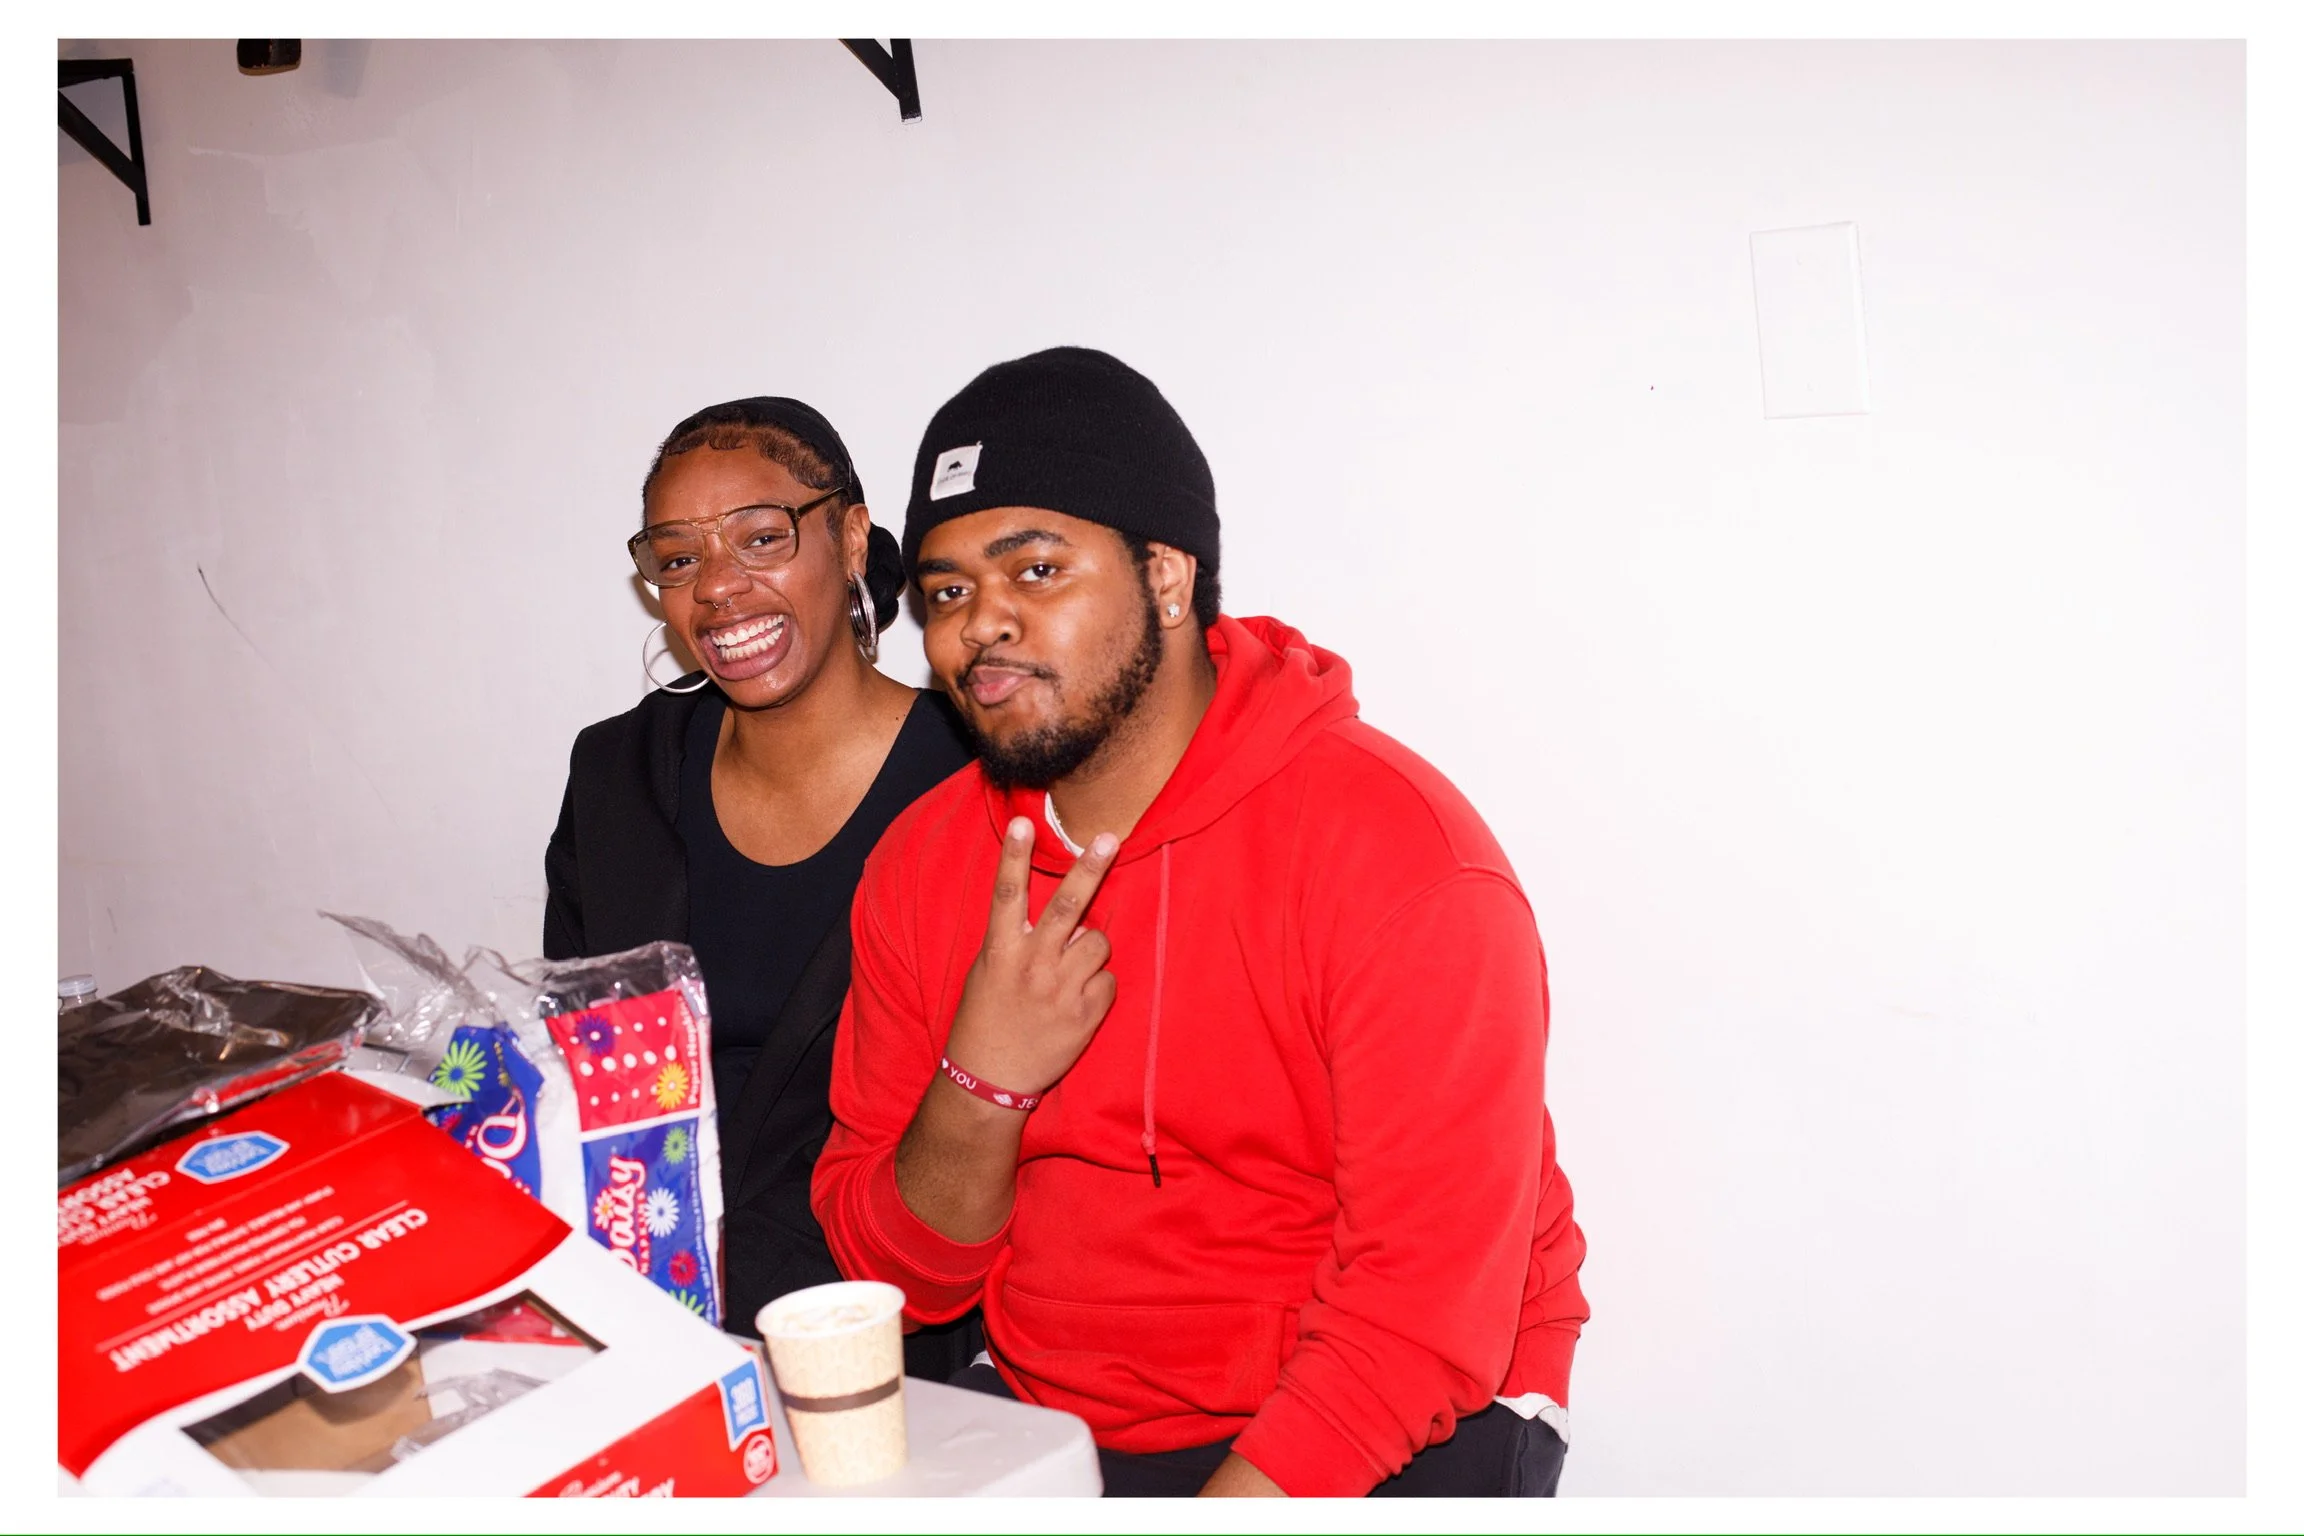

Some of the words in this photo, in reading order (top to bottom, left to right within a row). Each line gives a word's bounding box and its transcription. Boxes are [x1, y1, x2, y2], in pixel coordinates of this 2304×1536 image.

[687, 1059, 700, 1104] Paper
[950, 1067, 977, 1090] YOU
[356, 1208, 429, 1249] CLEAR
[264, 1241, 361, 1298] CUTLERY
[289, 1272, 345, 1307] HEAVY
[109, 1286, 262, 1373] ASSORTMENT
[243, 1299, 292, 1332] DUTY
